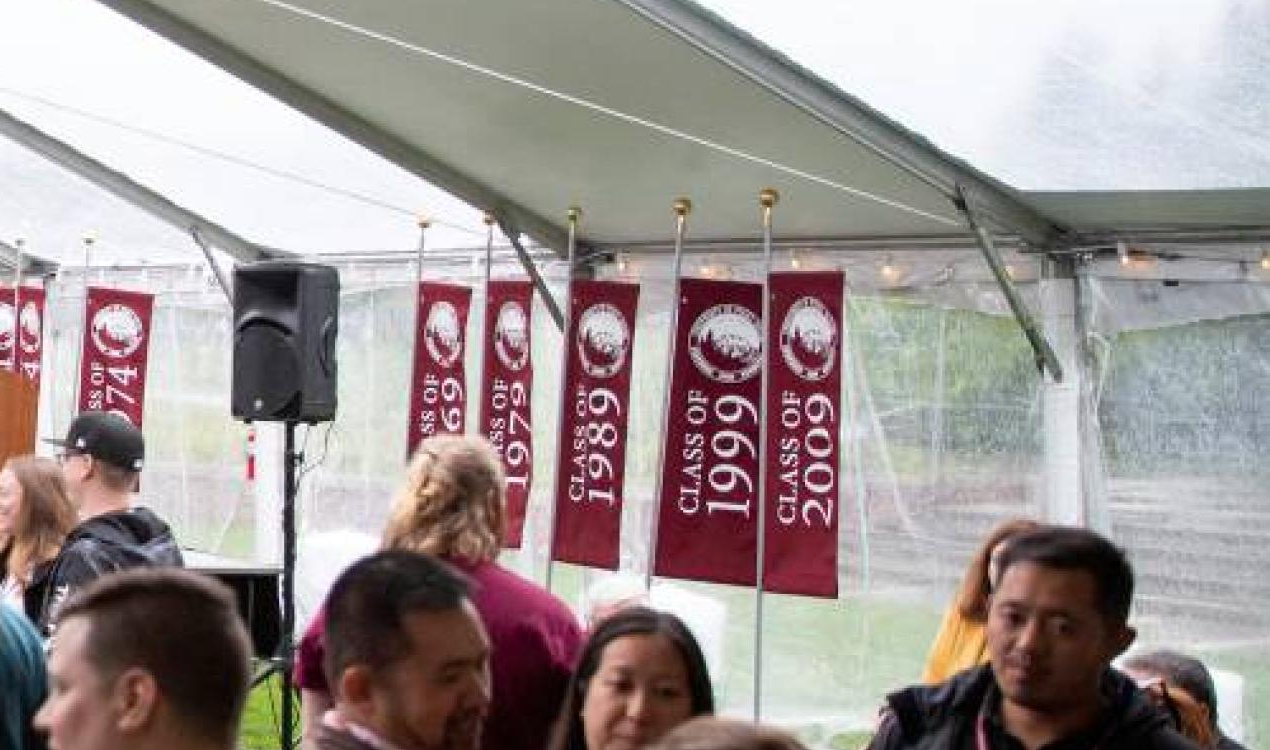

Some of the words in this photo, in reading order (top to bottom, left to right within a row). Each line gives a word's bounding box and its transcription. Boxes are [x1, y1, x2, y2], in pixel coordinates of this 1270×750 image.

[91, 362, 106, 387] OF
[424, 373, 440, 403] OF
[440, 377, 463, 431] 69
[493, 378, 508, 410] OF
[575, 385, 588, 416] OF
[504, 381, 531, 489] 1979
[687, 390, 708, 425] OF
[781, 390, 801, 428] OF
[570, 425, 585, 502] CLASS
[587, 387, 621, 506] 1989
[679, 433, 705, 515] CLASS
[707, 395, 758, 519] 1999
[802, 394, 834, 527] 2009
[777, 437, 801, 525] CLASS
